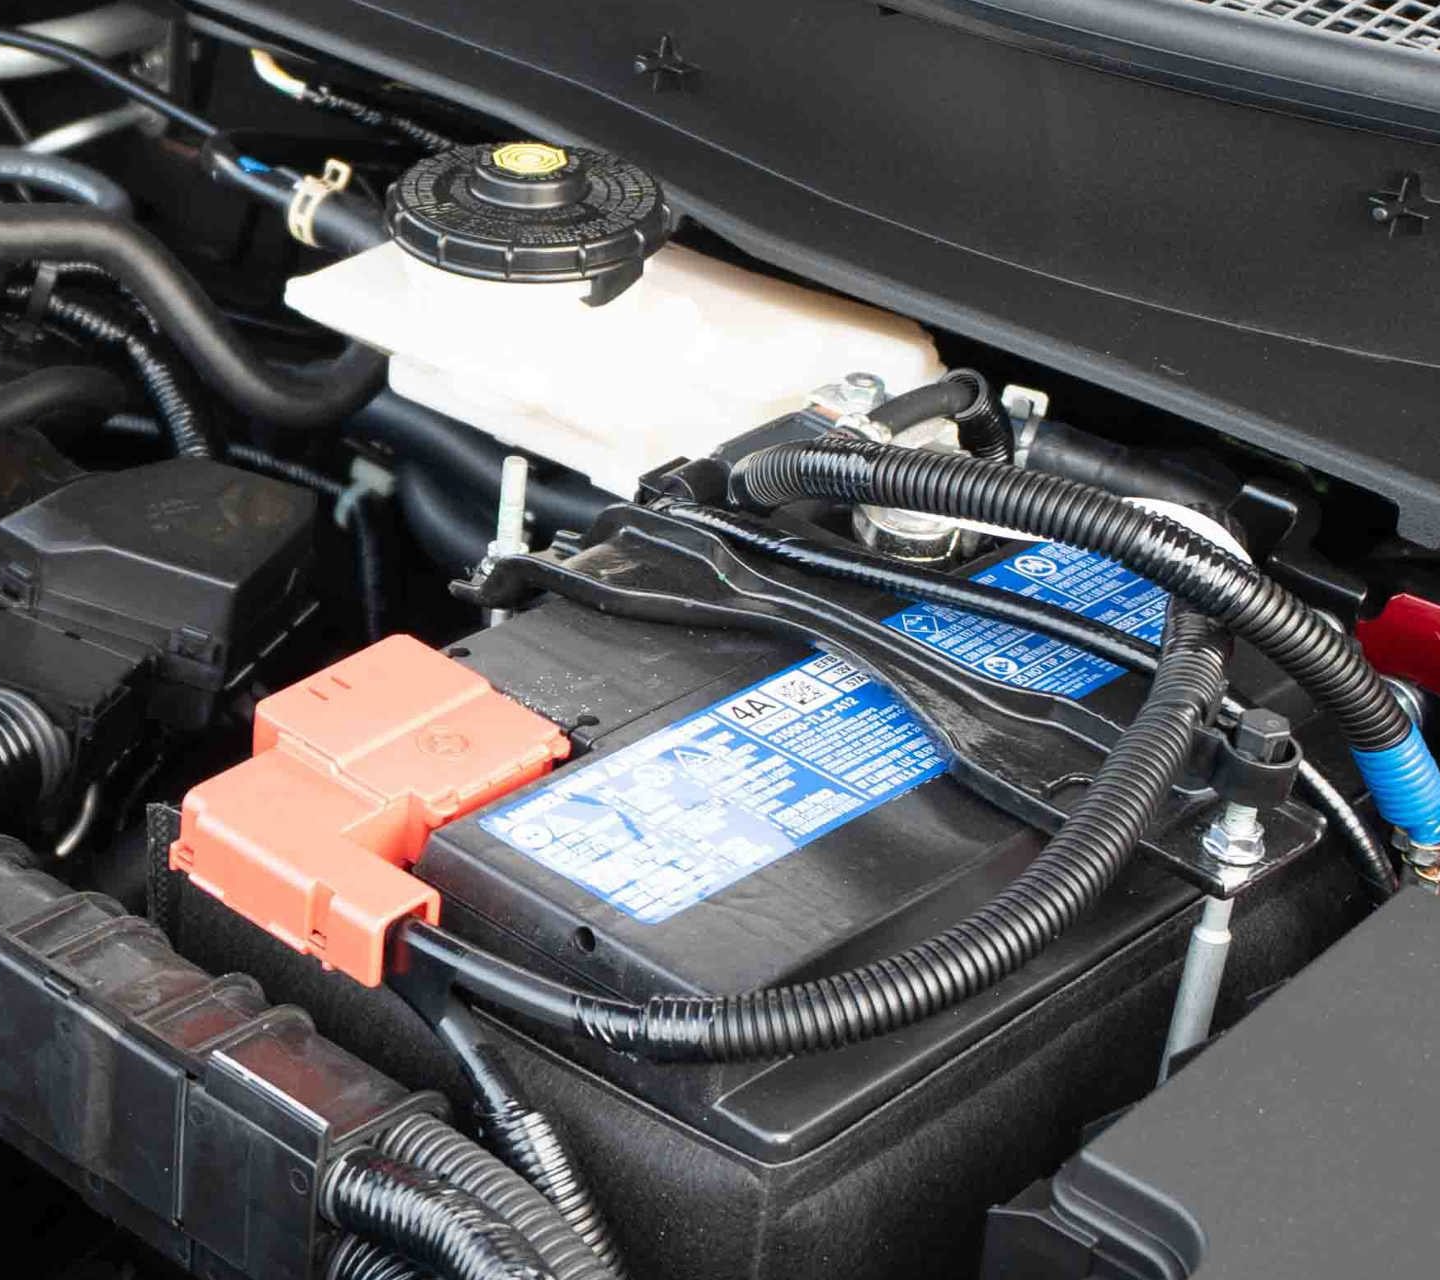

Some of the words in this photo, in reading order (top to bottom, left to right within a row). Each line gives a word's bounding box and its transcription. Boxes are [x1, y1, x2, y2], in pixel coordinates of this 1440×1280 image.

[810, 653, 840, 669] EFB
[1009, 673, 1030, 684] DO
[1021, 664, 1049, 678] NOT
[724, 693, 778, 723] 4A
